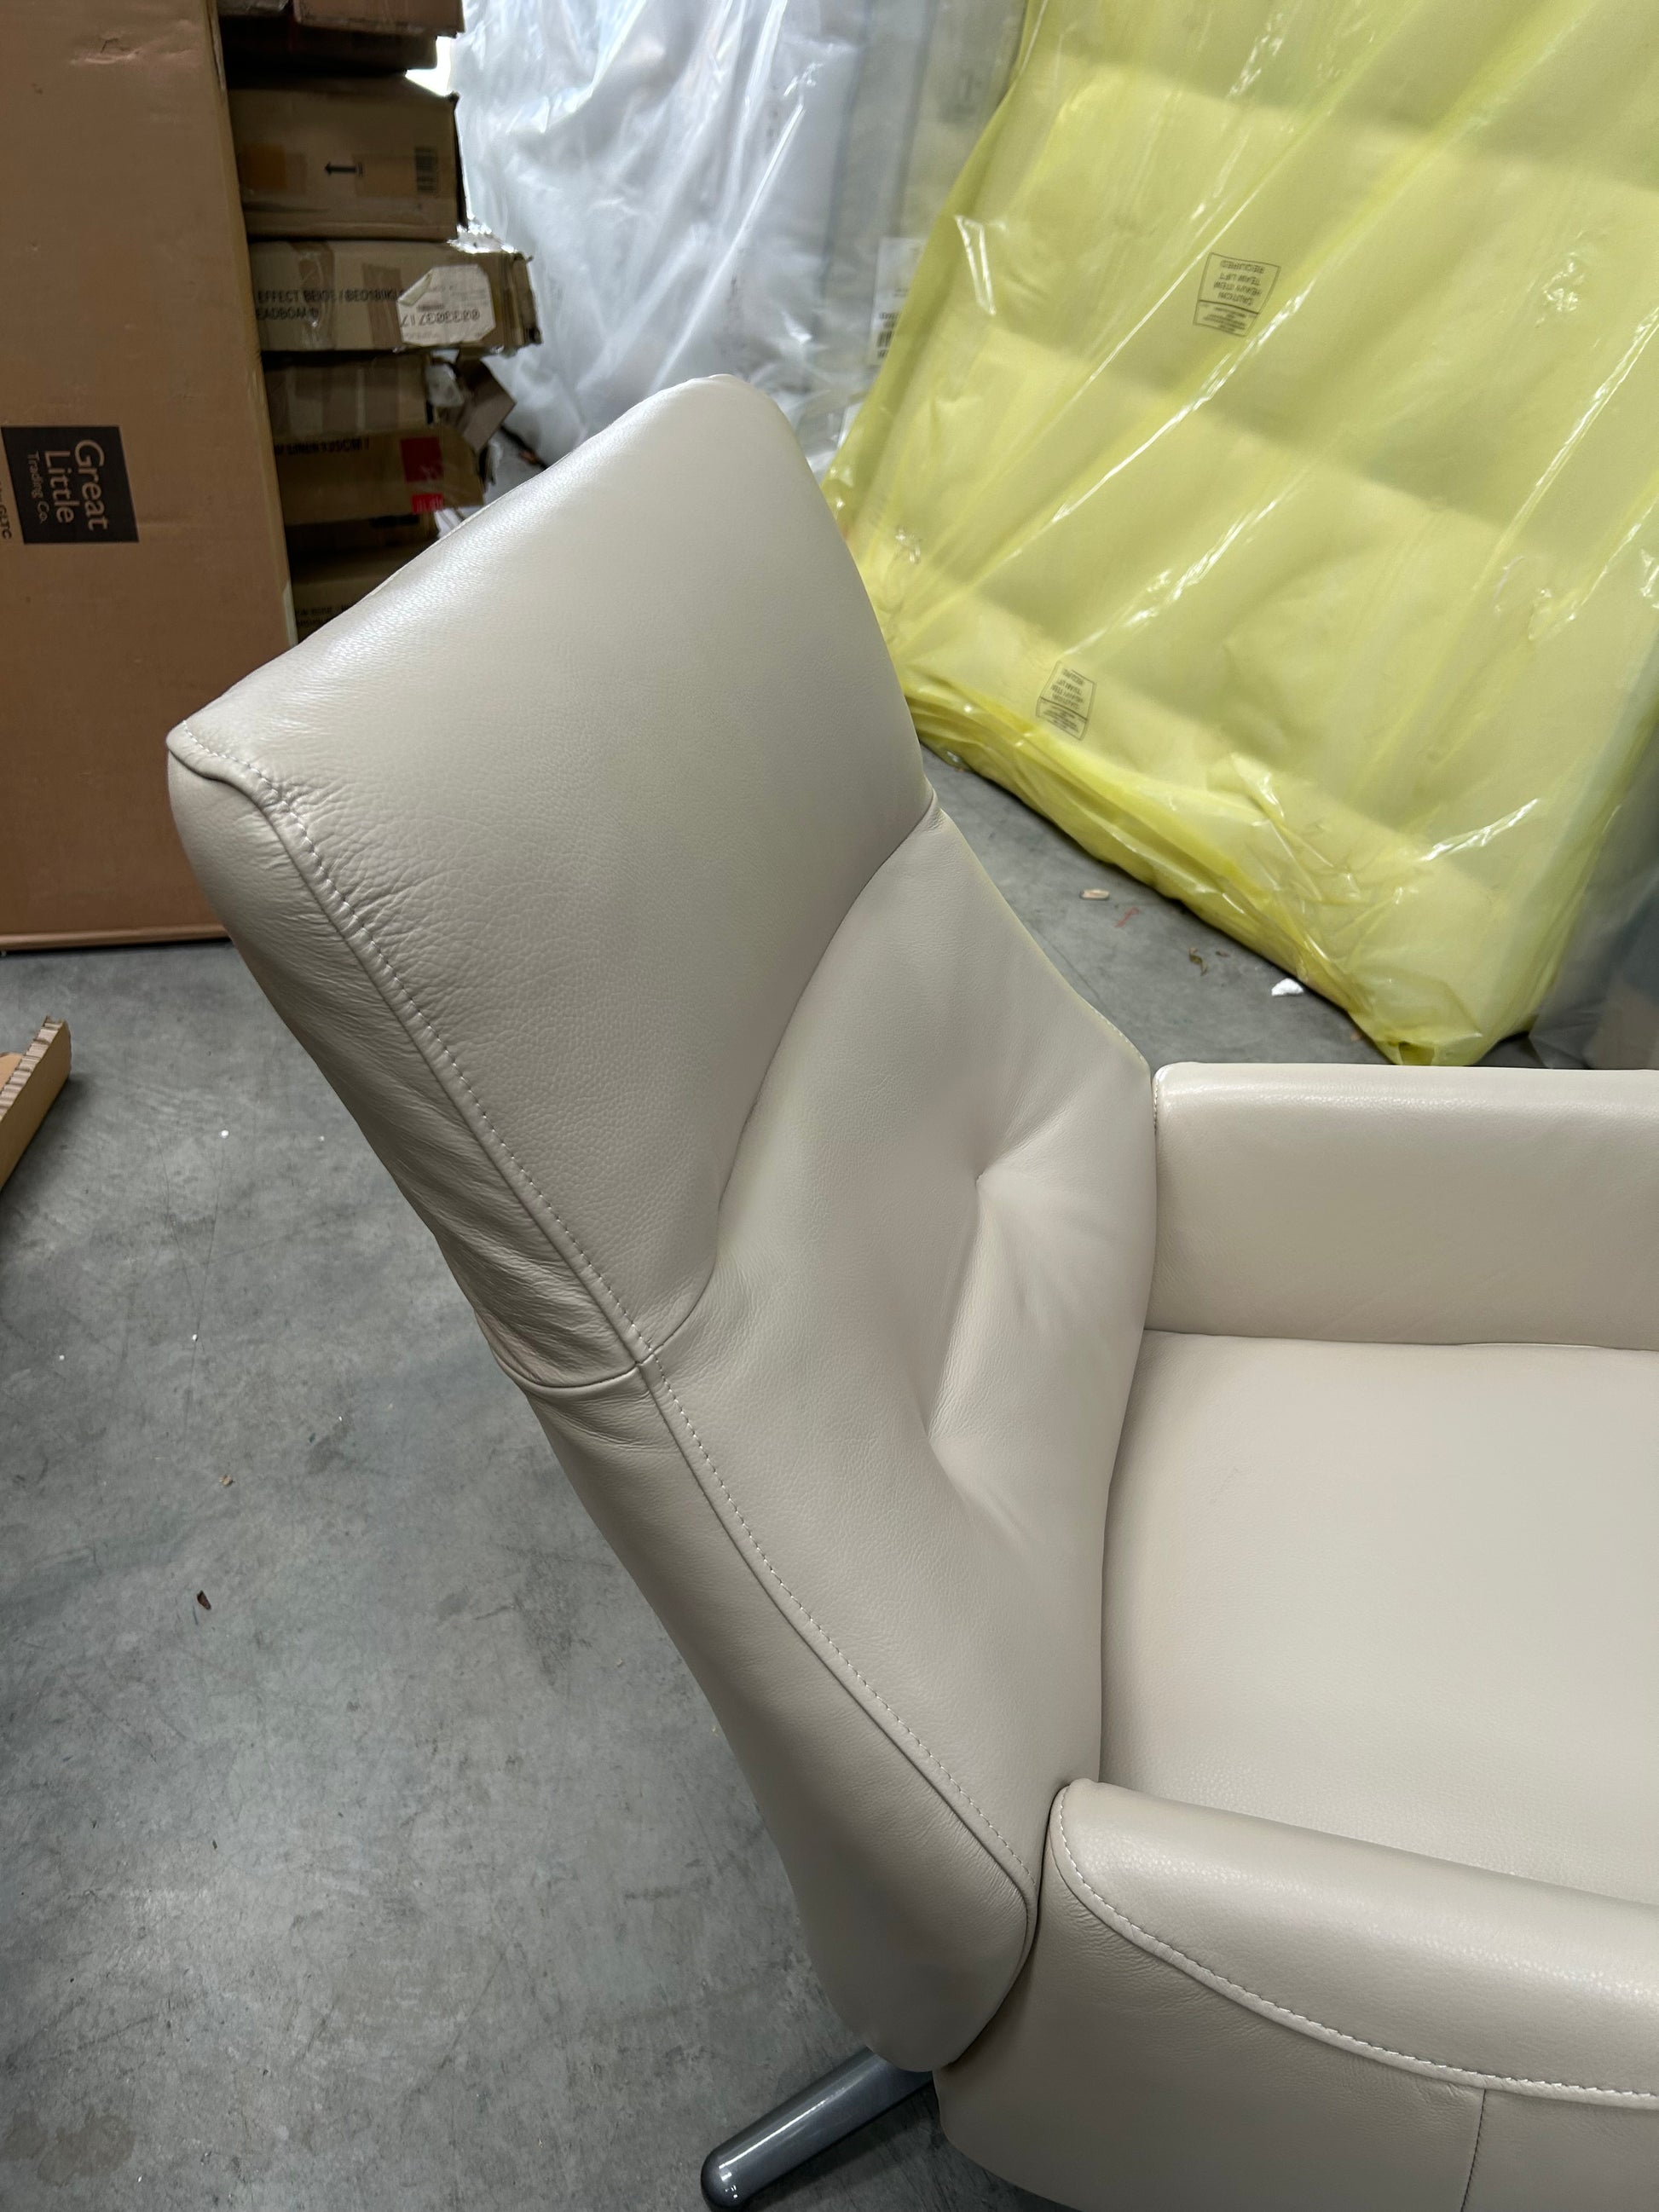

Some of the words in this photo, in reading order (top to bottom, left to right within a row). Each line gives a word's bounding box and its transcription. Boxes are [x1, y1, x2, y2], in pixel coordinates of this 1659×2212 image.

[27, 451, 43, 500] Trading
[44, 450, 80, 523] Little
[75, 439, 109, 531] Great
